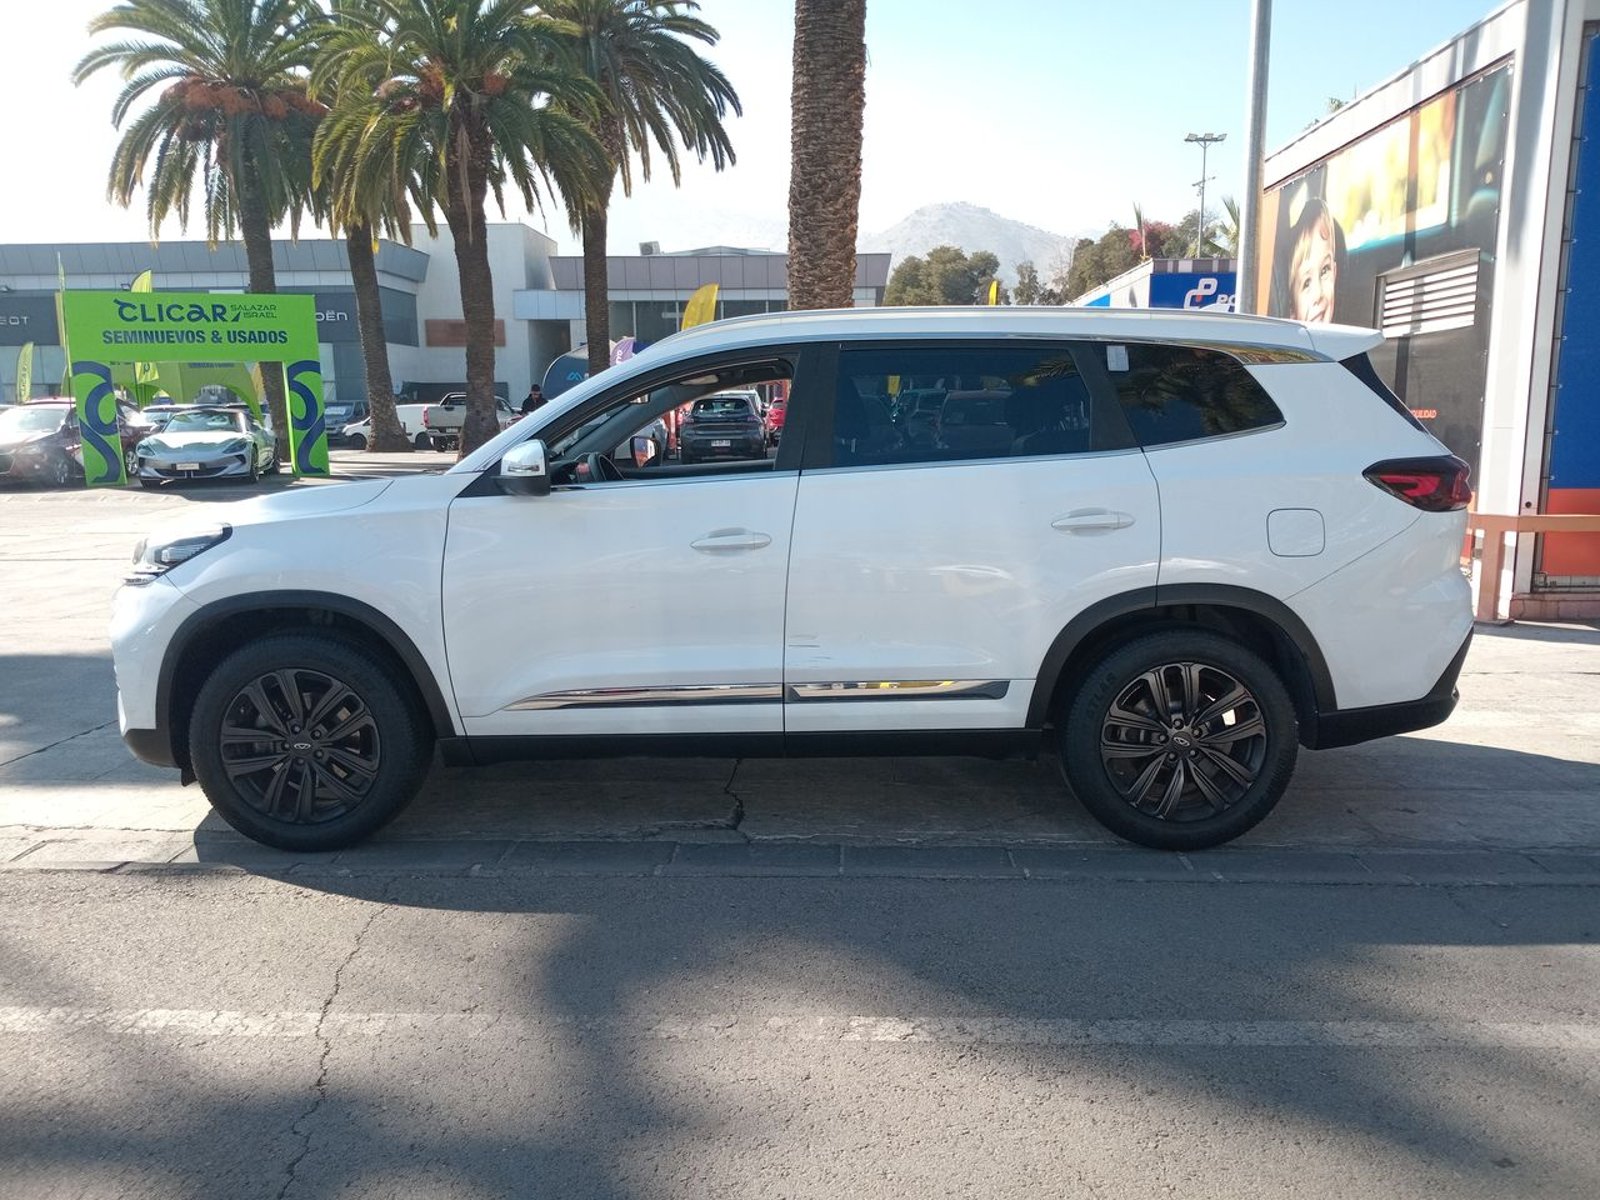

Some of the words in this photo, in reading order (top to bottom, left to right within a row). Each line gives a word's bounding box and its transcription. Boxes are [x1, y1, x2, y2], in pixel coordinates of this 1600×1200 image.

[243, 311, 278, 319] ISRAEL
[102, 330, 206, 344] SEMINUEVOS
[211, 330, 223, 344] &
[227, 330, 288, 344] USADOS
